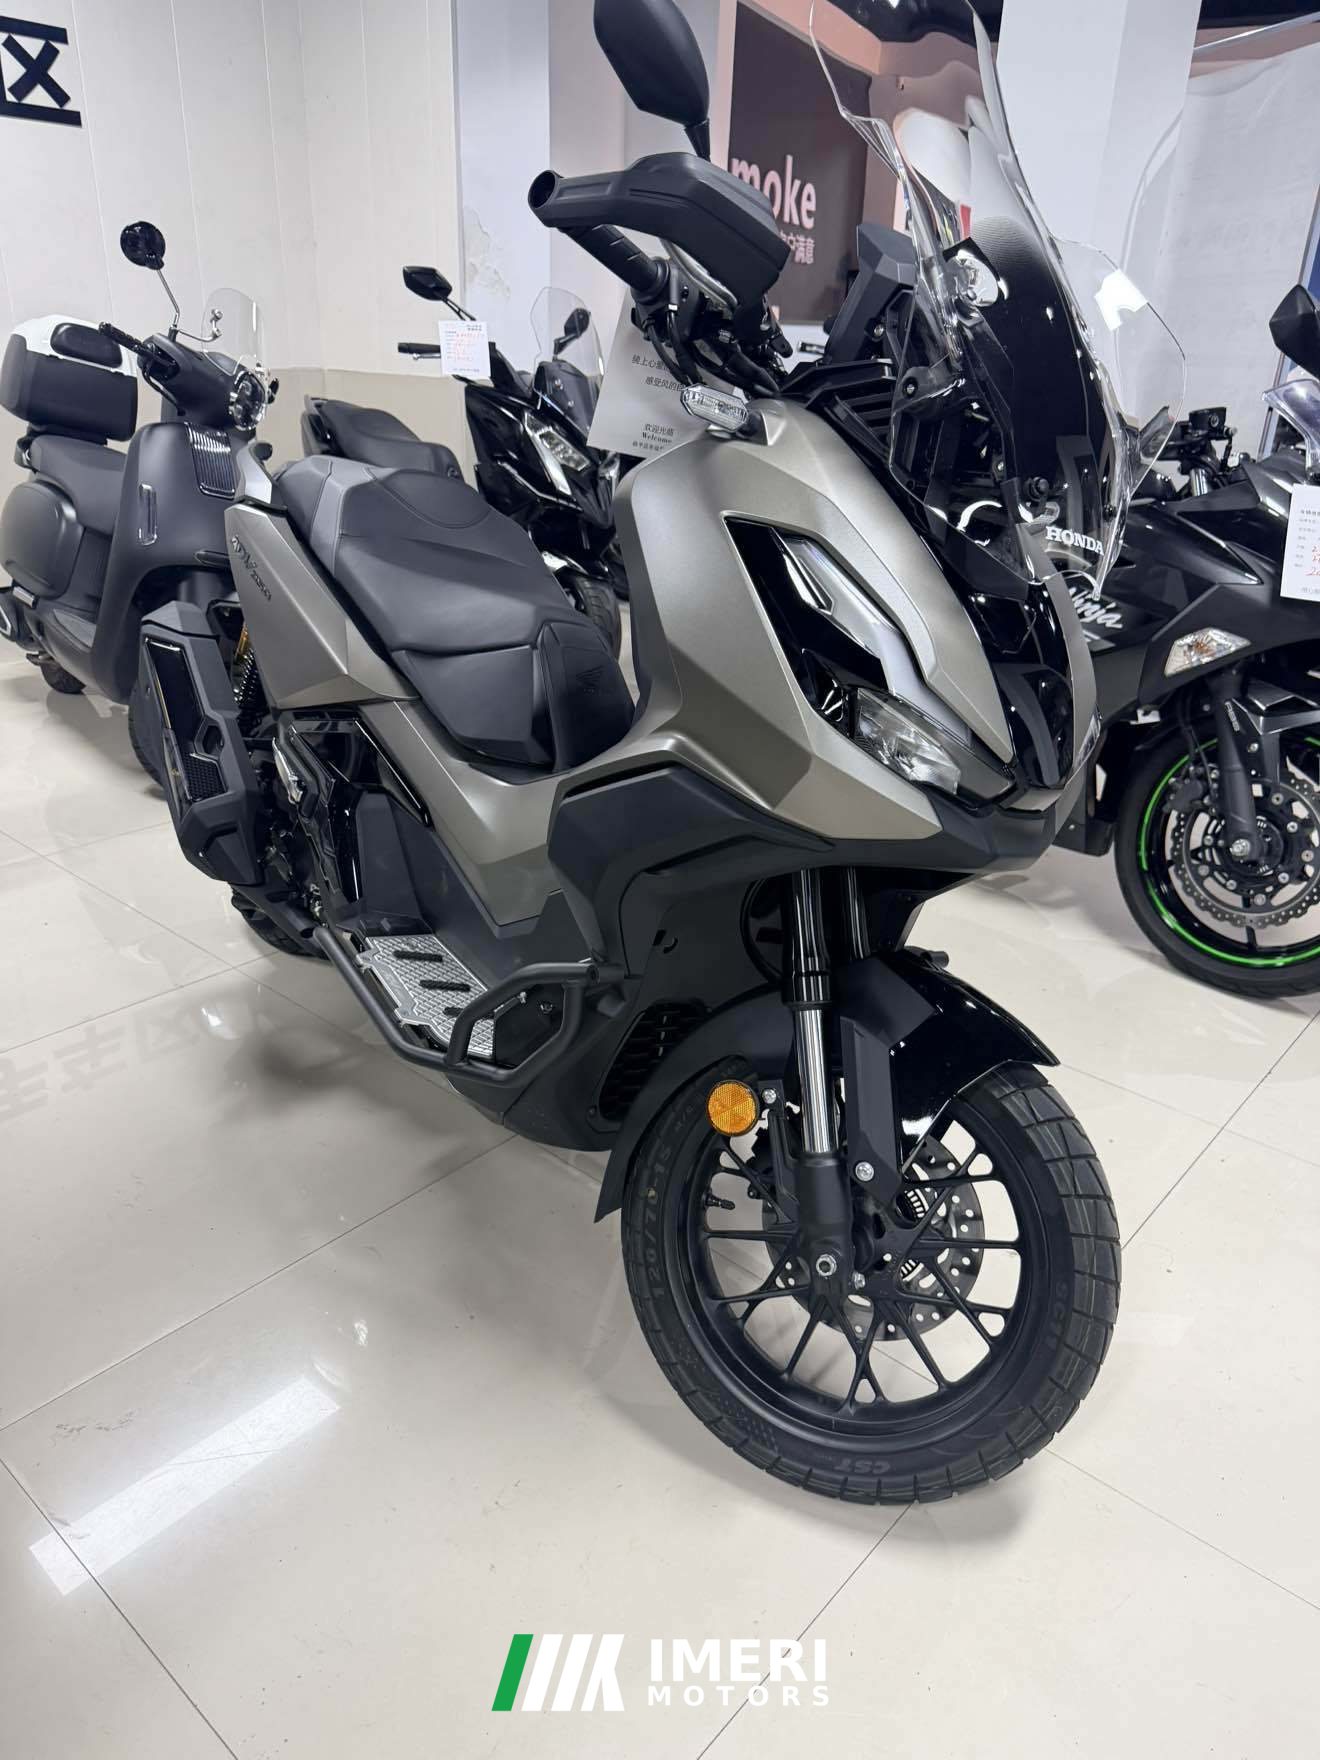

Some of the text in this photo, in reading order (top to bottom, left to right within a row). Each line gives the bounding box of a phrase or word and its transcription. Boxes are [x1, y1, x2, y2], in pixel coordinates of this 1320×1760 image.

[0, 15, 82, 128] 区
[642, 432, 673, 443] Welcome
[1045, 526, 1104, 556] HONDA
[833, 1456, 890, 1475] CST
